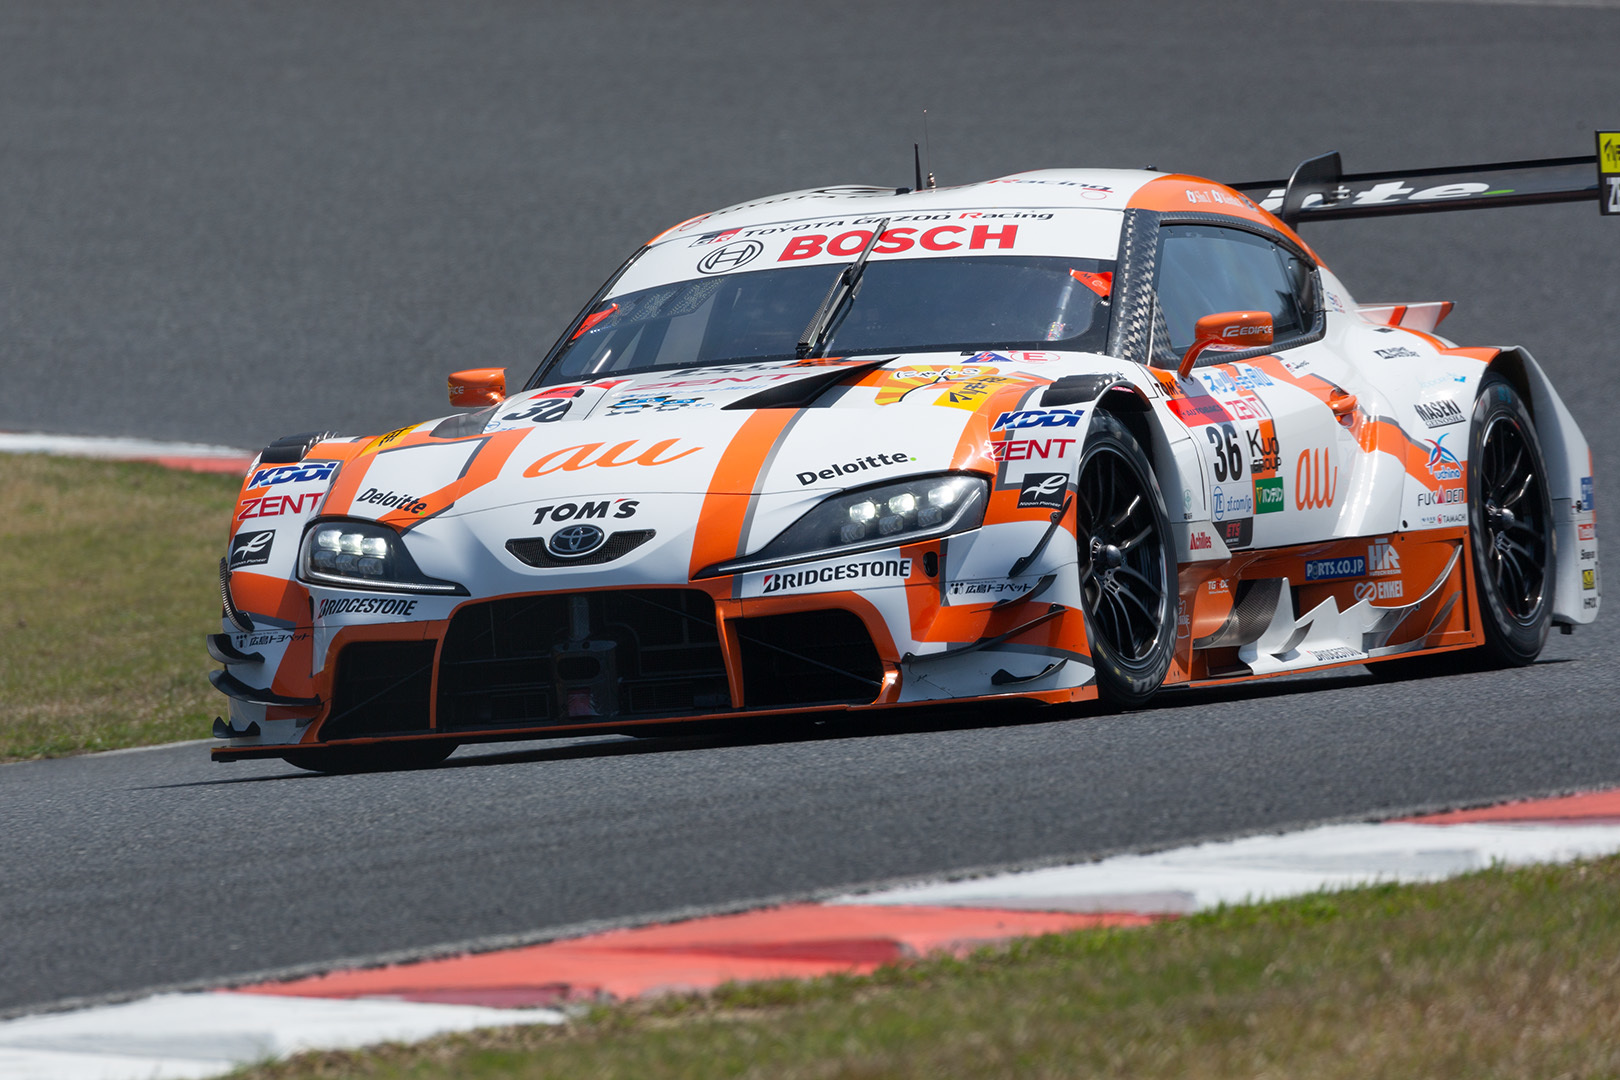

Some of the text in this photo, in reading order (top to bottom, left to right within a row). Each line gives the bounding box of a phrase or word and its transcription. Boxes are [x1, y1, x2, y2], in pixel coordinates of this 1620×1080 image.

[744, 220, 844, 238] TOYOTA
[958, 212, 1055, 221] Racing
[776, 224, 1019, 262] BOSCH
[993, 409, 1085, 431] KDDI
[1223, 397, 1267, 421] ZENT
[522, 437, 705, 479] au
[988, 438, 1077, 462] ZENT
[1205, 423, 1243, 483] 36
[247, 461, 340, 491] KDDI
[1295, 446, 1338, 512] au
[237, 491, 325, 521] ZENT
[532, 498, 640, 526] TOM'S
[762, 559, 912, 594] BRIDGESTONE
[317, 598, 418, 619] BRIDGESTONE
